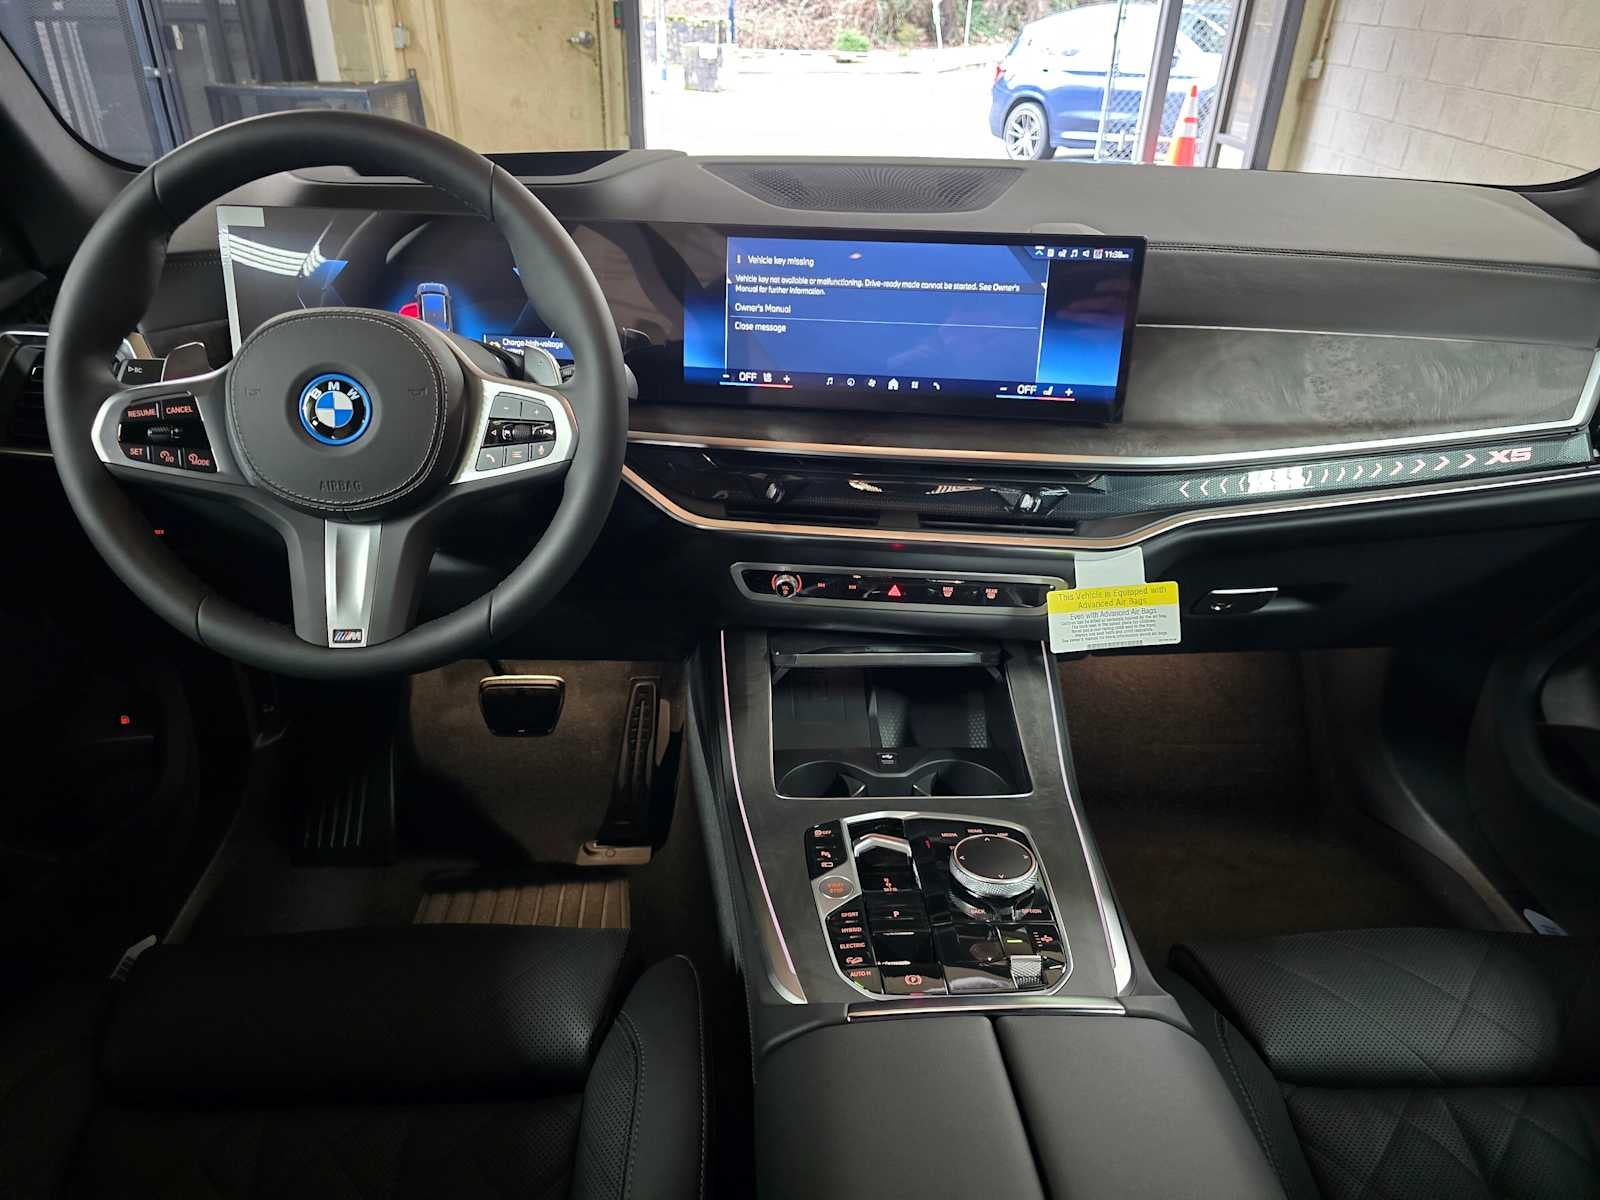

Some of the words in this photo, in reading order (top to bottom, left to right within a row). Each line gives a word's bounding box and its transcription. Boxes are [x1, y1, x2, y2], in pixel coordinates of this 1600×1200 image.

[747, 255, 773, 265] Vehicle
[773, 256, 786, 267] key
[787, 256, 815, 268] missing
[735, 274, 757, 283] Vehicle
[758, 275, 769, 284] key
[770, 276, 780, 284] not
[781, 276, 808, 285] available
[865, 278, 901, 289] Drive-ready
[902, 281, 920, 289] mode
[921, 281, 943, 290] cannot
[944, 282, 953, 290] be
[979, 283, 991, 291] See
[735, 284, 758, 293] Manual
[759, 285, 767, 293] for
[768, 285, 789, 295] further
[735, 303, 763, 313] Owner's
[765, 304, 791, 314] Manual
[734, 322, 754, 331] Close
[755, 323, 786, 334] message
[502, 338, 525, 347] Charge
[739, 372, 757, 382] OFF
[310, 381, 360, 401] BMW
[1017, 385, 1036, 395] OFF
[127, 408, 157, 418] RESUME
[165, 405, 193, 415] CANCEL
[129, 448, 143, 456] SET
[1484, 447, 1532, 465] X5
[320, 479, 362, 493] AIRBAG
[1057, 593, 1074, 602] This
[1076, 591, 1104, 600] Vehicle
[1104, 590, 1111, 598] is
[1113, 587, 1148, 598] Equipped
[1150, 585, 1167, 594] with
[1078, 599, 1114, 609] Advanced
[1115, 598, 1126, 607] Air
[1128, 598, 1148, 607] Bags
[1070, 613, 1085, 621] Even
[1086, 611, 1099, 620] with
[1100, 609, 1130, 618] Advanced
[1141, 607, 1158, 616] Bags
[839, 942, 866, 950] ELECTRIC
